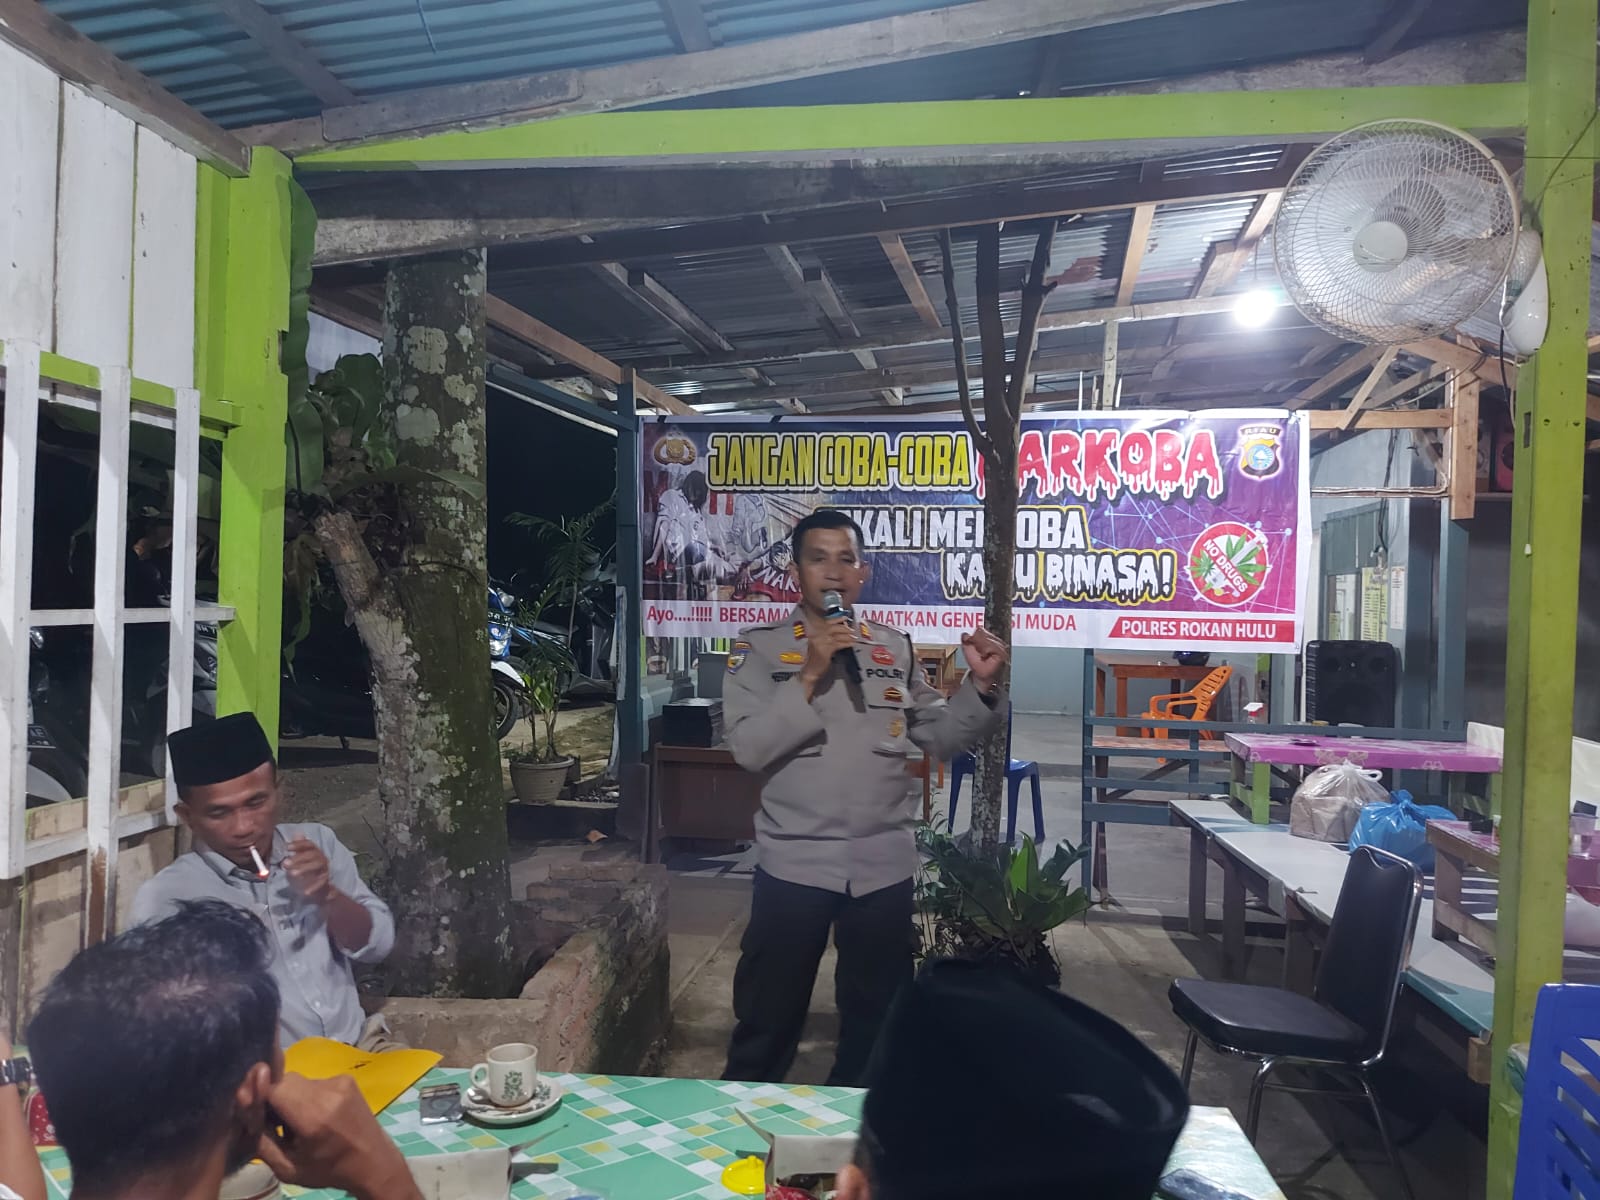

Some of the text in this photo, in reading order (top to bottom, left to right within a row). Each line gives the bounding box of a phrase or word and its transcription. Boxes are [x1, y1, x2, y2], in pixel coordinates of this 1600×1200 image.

[1244, 426, 1277, 434] RIAU
[708, 430, 1222, 500] JANGAN COBA-COBA ARKOBA
[836, 509, 1084, 549] KALI MEOBA
[946, 552, 1172, 599] KAU BINASA!
[1203, 539, 1248, 593] NO DRUGS
[861, 610, 938, 627] AMATKAN
[941, 611, 1021, 629] GENESI
[1025, 614, 1077, 631] MUDA
[1121, 620, 1276, 639] POLRES ROKAN HULU
